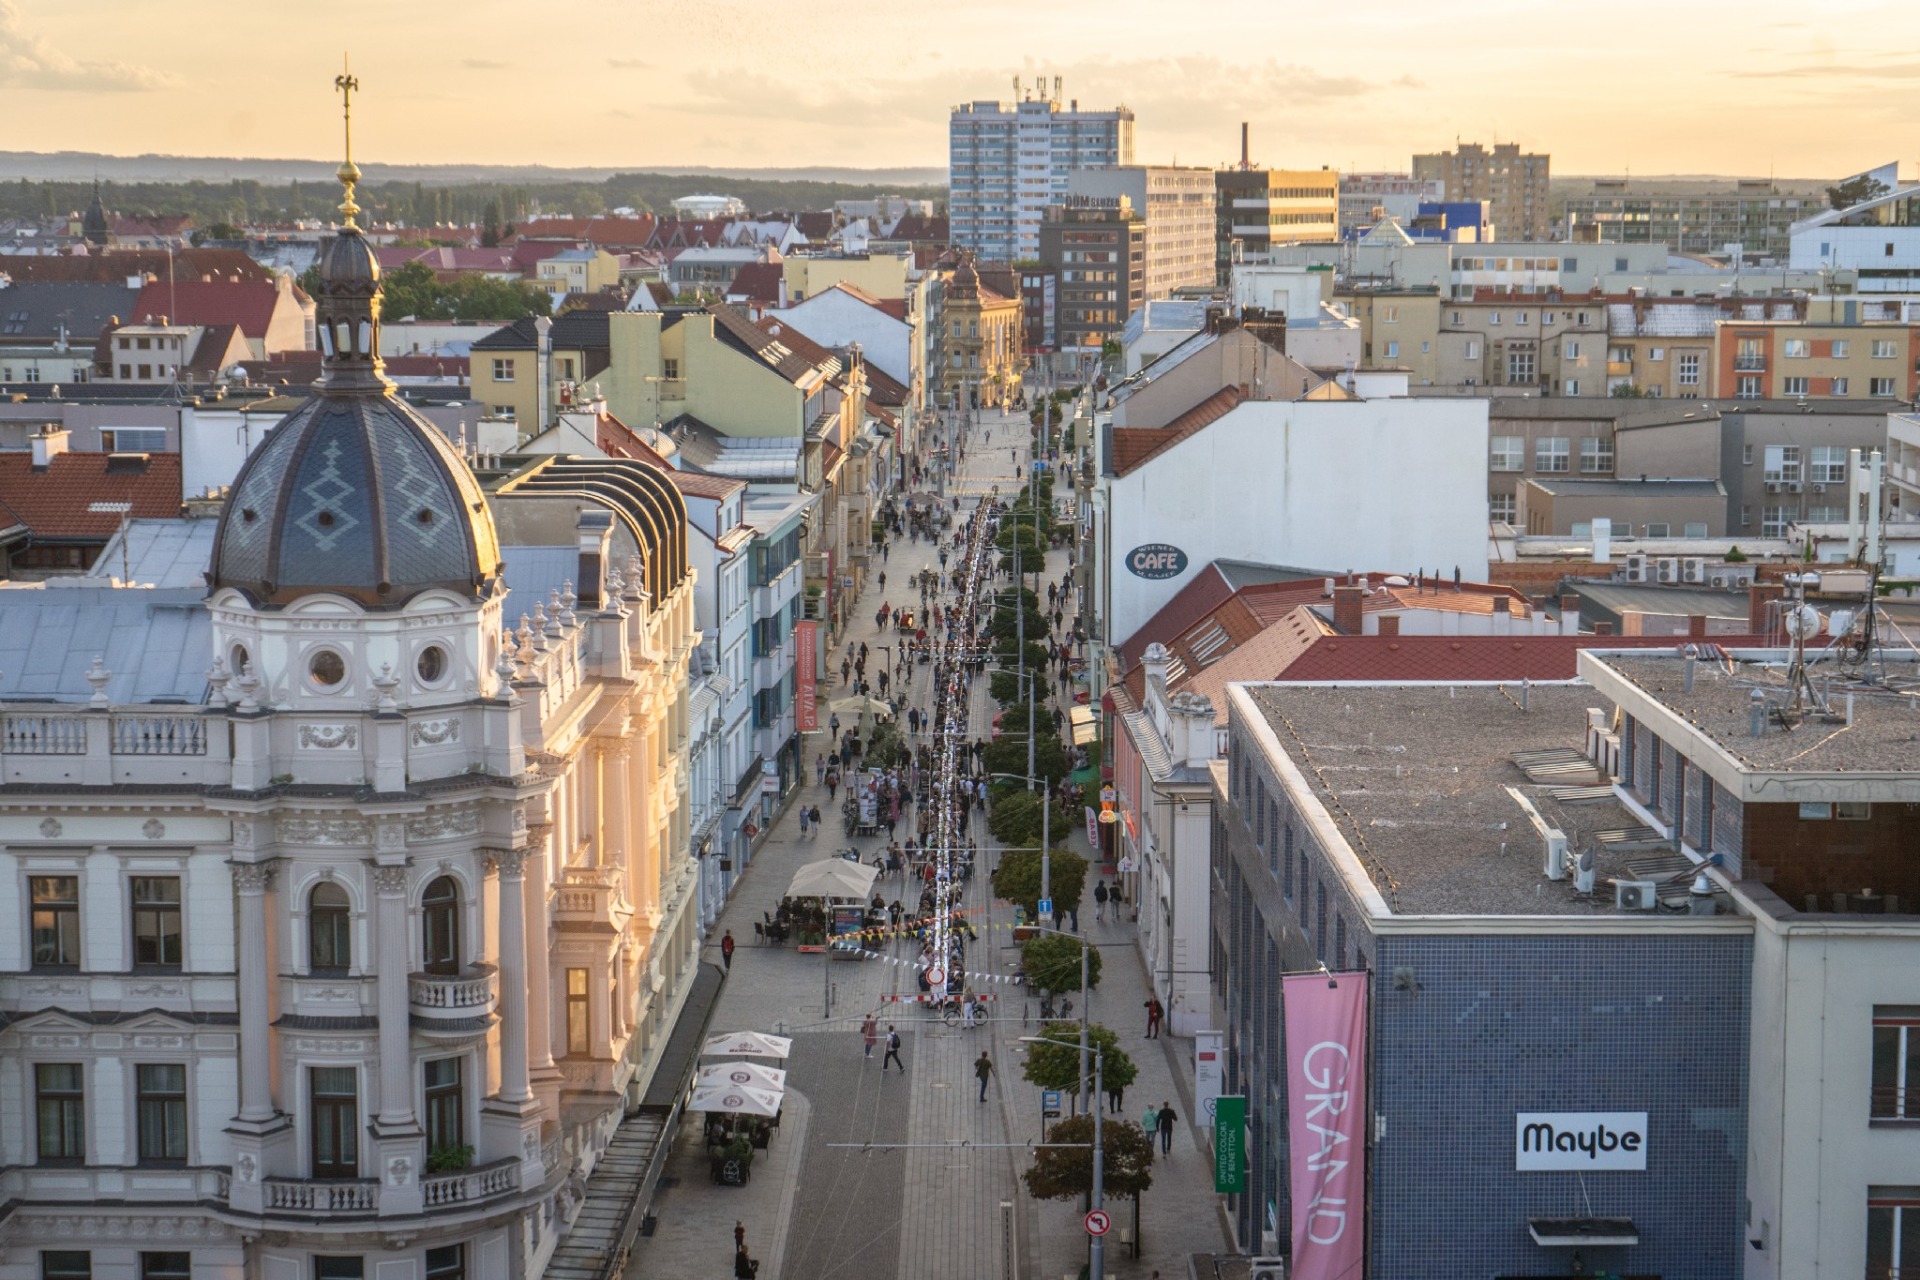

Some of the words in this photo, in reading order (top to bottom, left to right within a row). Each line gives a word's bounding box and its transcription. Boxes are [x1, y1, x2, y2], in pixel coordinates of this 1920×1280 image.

[1134, 553, 1178, 569] CAFE
[1303, 1041, 1350, 1245] GRAND
[1523, 1123, 1641, 1159] Maybe
[1228, 1173, 1236, 1185] OF
